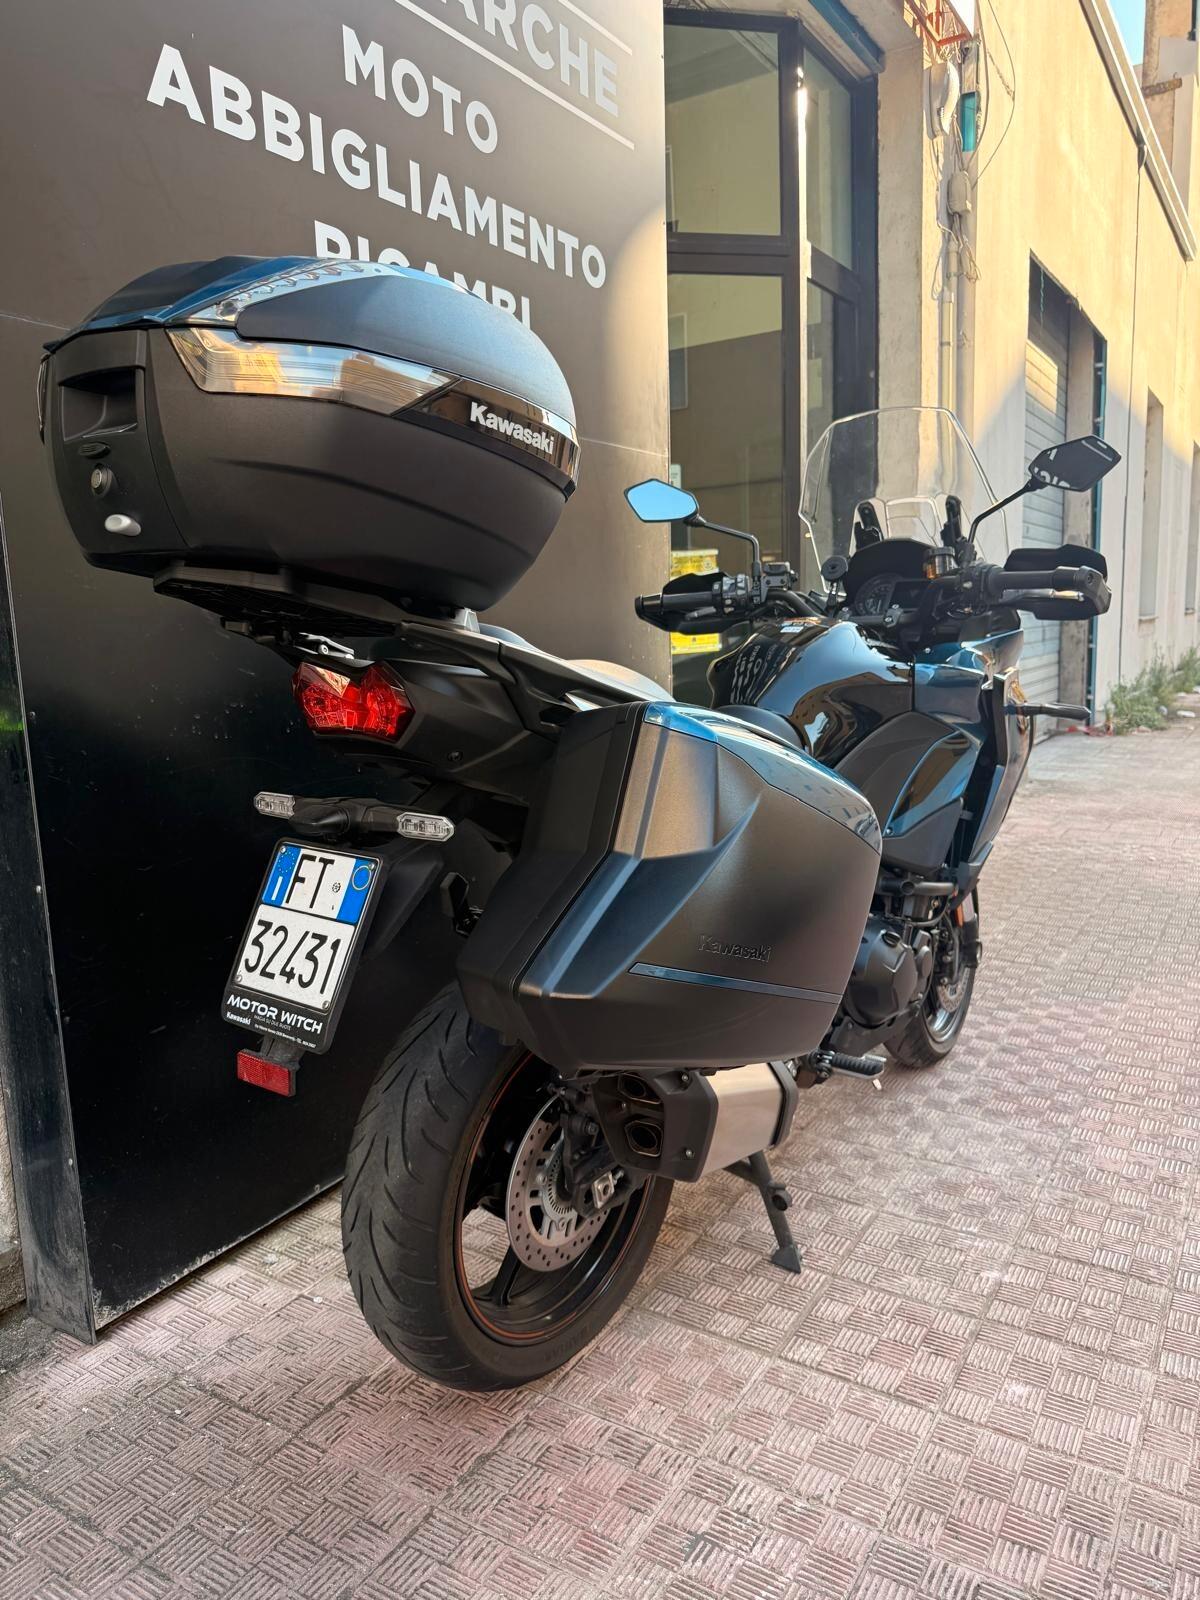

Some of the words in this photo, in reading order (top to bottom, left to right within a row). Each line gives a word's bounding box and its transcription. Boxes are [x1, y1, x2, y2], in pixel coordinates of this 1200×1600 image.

[342, 23, 498, 154] MOTO
[147, 43, 606, 289] ABBIGLIAMENTO
[470, 401, 554, 455] Kawasaki
[285, 854, 335, 908] FT
[244, 919, 342, 995] 32431
[698, 934, 772, 963] Kawasaki
[226, 994, 278, 1020] MOTOR
[280, 1010, 323, 1035] WITCH
[226, 1011, 252, 1026] Kawasaki
